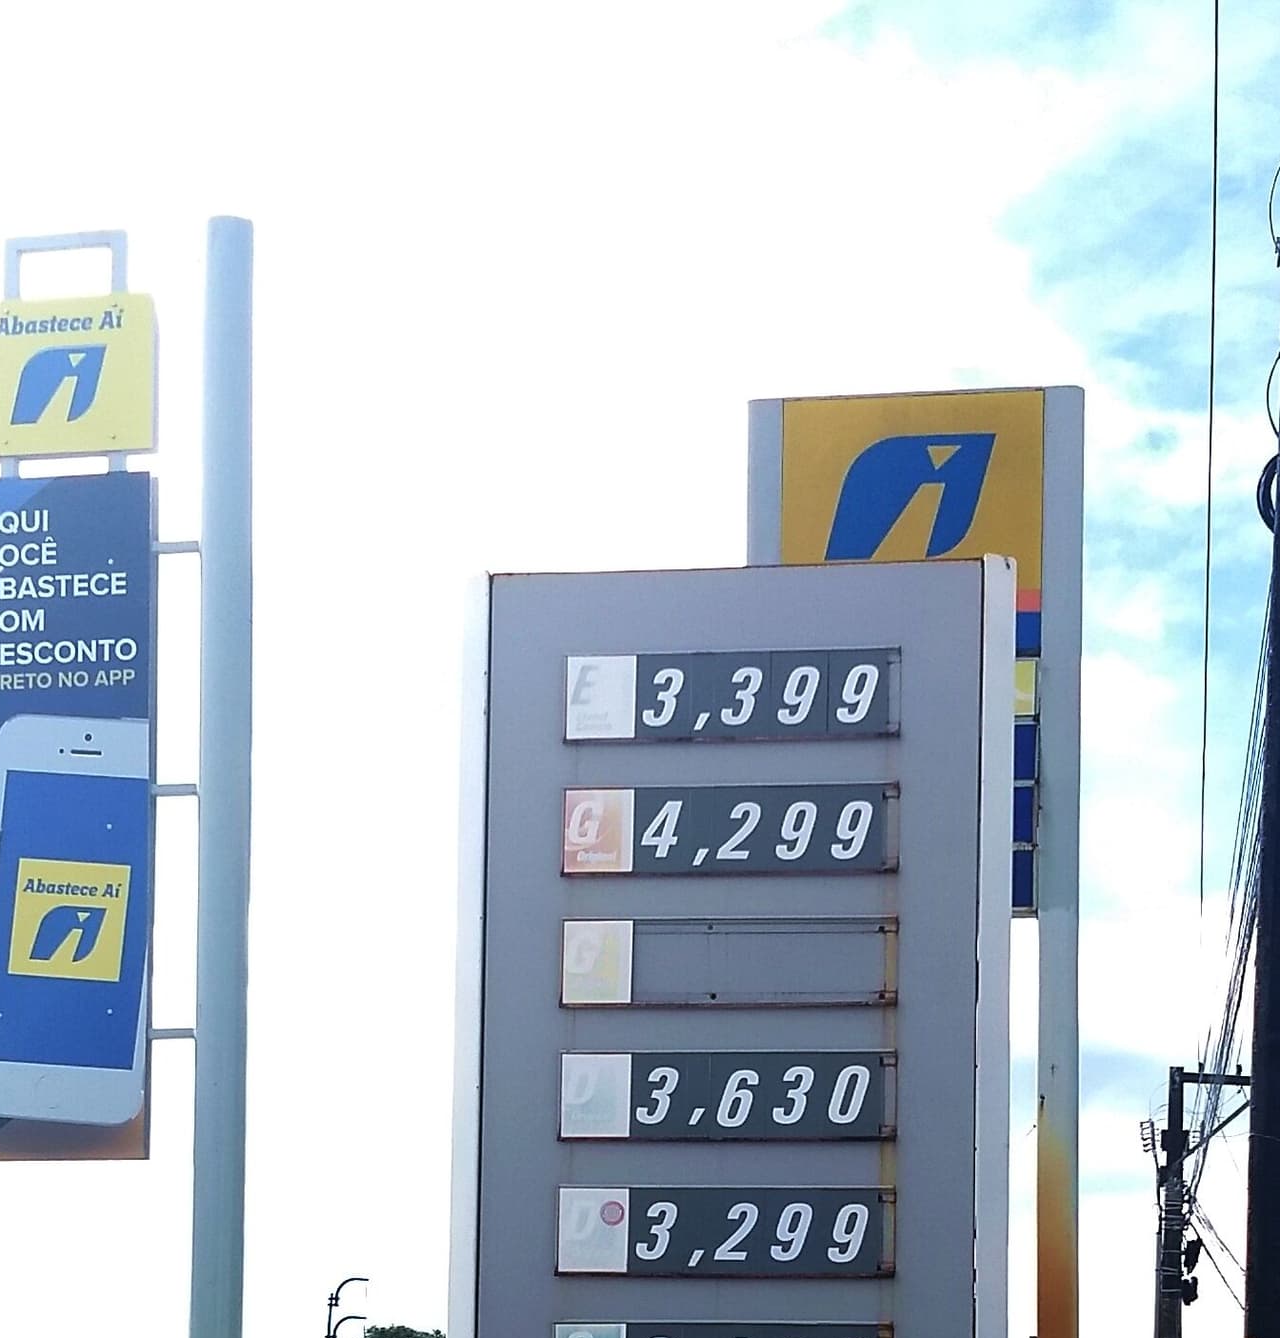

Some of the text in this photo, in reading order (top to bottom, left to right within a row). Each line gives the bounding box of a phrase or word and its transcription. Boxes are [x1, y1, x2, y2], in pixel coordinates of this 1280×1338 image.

[58, 671, 89, 690] NO
[94, 669, 136, 688] APP
[642, 664, 879, 731] 3,399
[640, 800, 874, 867] 4,299
[22, 877, 98, 898] Abastece
[635, 1065, 871, 1128] 3,630
[635, 1201, 870, 1268] 3,299
